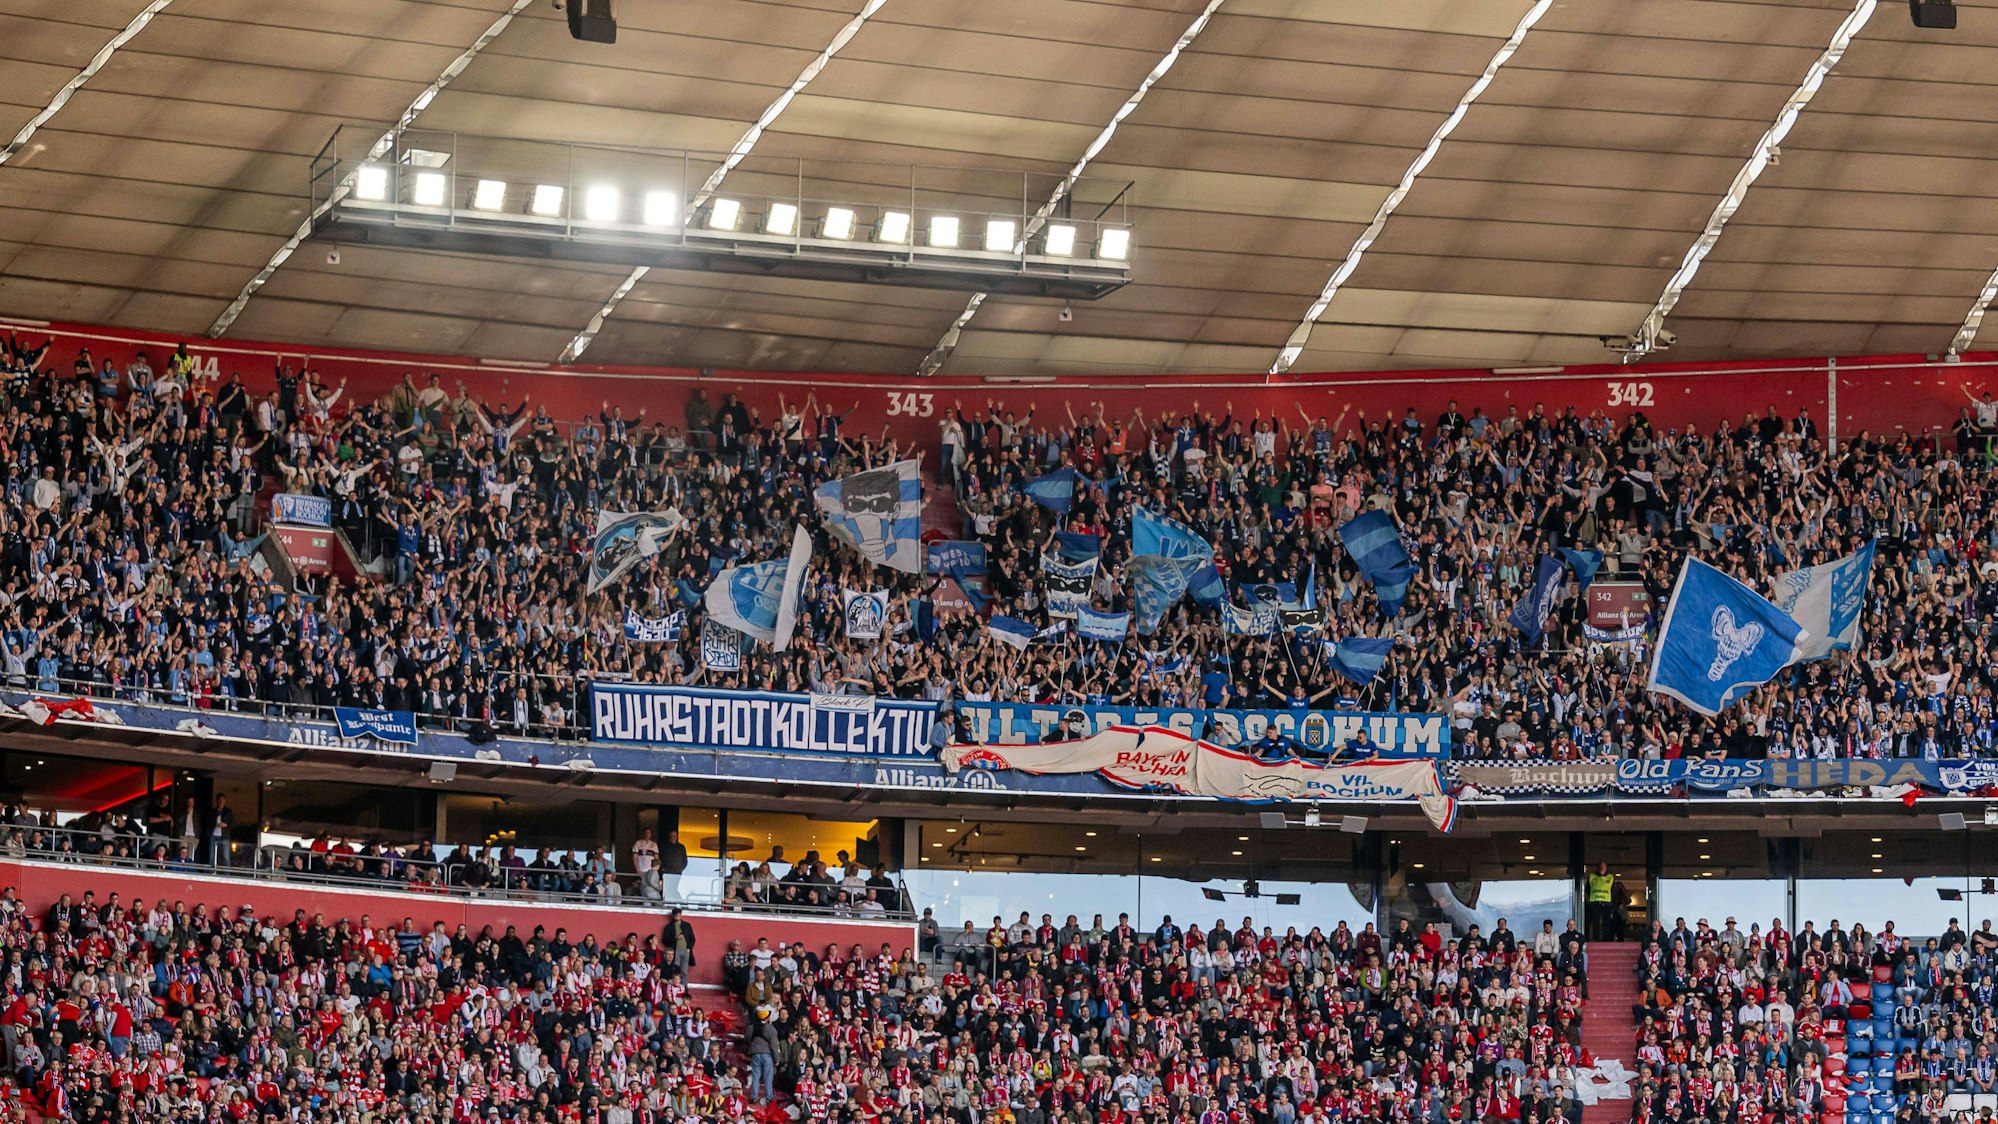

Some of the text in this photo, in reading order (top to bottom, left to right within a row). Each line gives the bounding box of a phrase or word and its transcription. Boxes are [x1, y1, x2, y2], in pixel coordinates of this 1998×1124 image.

[191, 355, 220, 381] 44
[886, 391, 934, 418] 343
[1607, 382, 1655, 407] 342
[279, 533, 293, 546] 44
[308, 558, 328, 566] Arena
[1597, 592, 1612, 601] 342
[634, 624, 670, 641] 4630
[705, 648, 738, 667] STADT
[358, 711, 394, 723] West
[594, 691, 936, 756] RUHRSTADTKOLLEKTIV
[875, 768, 959, 789] Allianz
[1508, 766, 1617, 788] Bochum
[1618, 758, 1671, 779] Old
[1773, 761, 1928, 788] HEDA
[1307, 780, 1404, 798] BOCHUM
[1342, 773, 1374, 787] VfL
